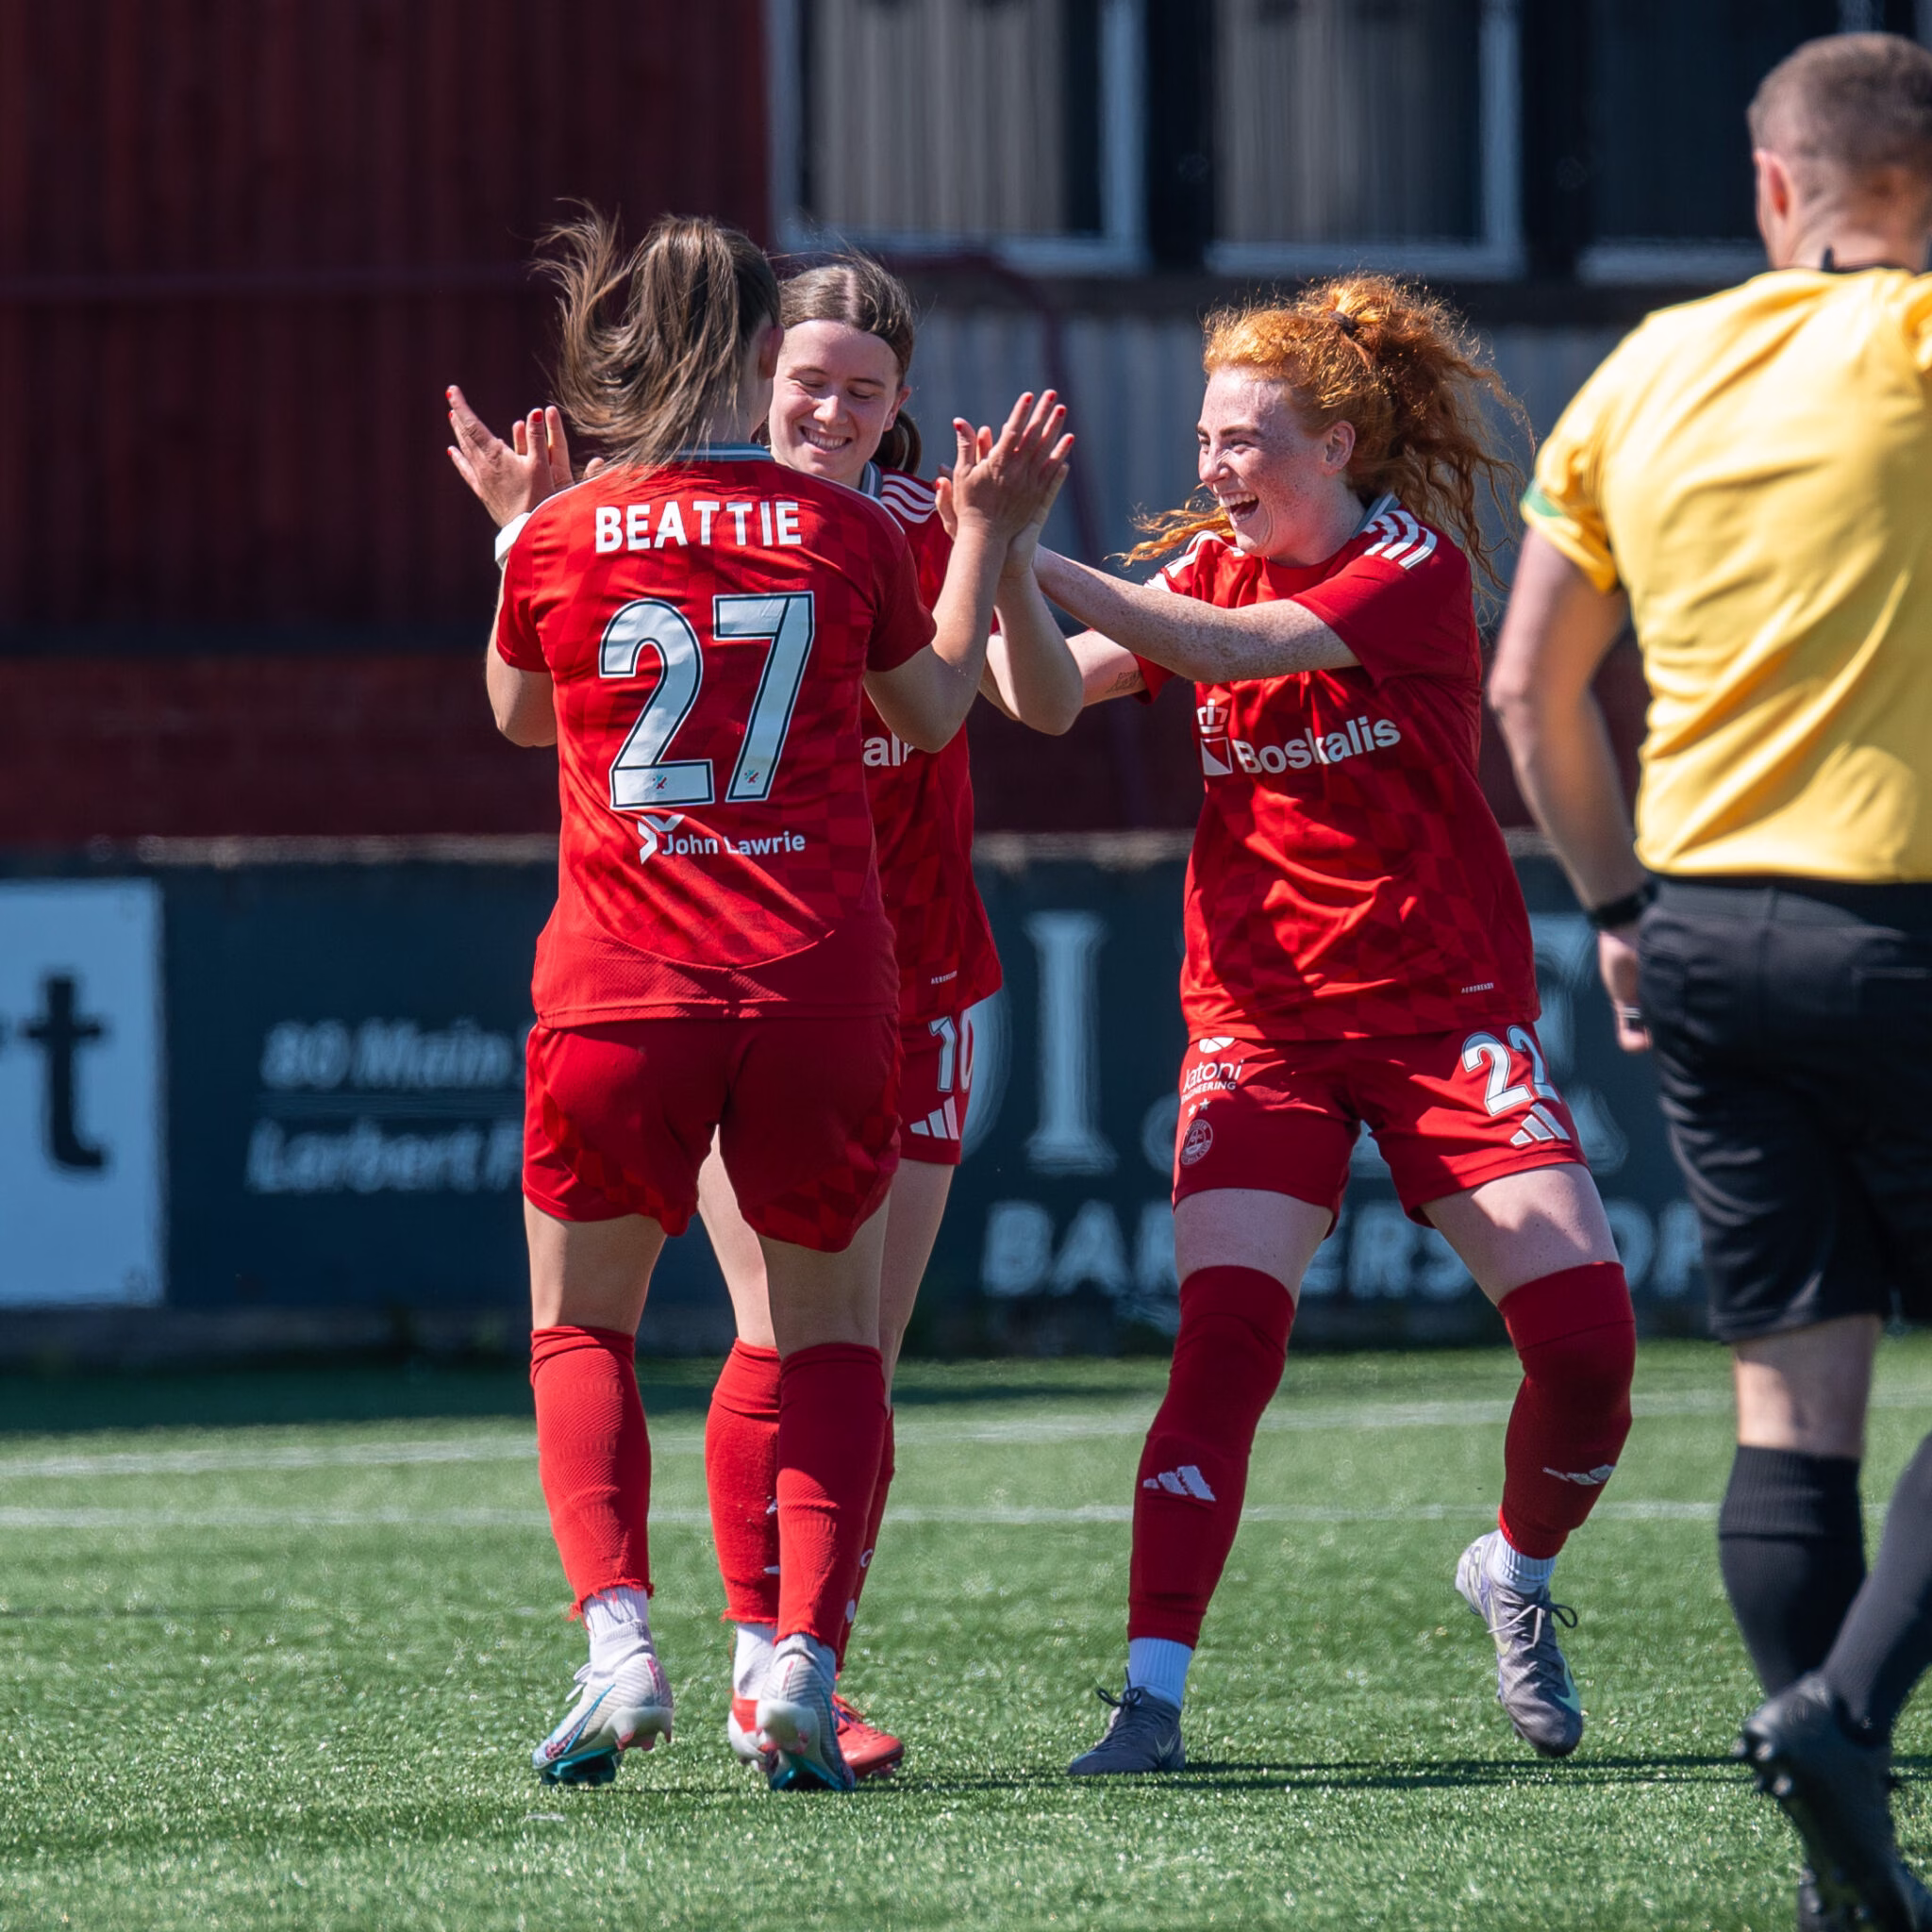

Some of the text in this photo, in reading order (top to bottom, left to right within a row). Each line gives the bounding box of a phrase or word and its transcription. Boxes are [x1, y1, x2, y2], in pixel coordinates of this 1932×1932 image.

[595, 501, 802, 554] BEATTIE
[599, 591, 815, 810] 27
[1231, 715, 1402, 774] Boskalis
[661, 830, 807, 856] John Lawrie
[1461, 1024, 1562, 1118] 22
